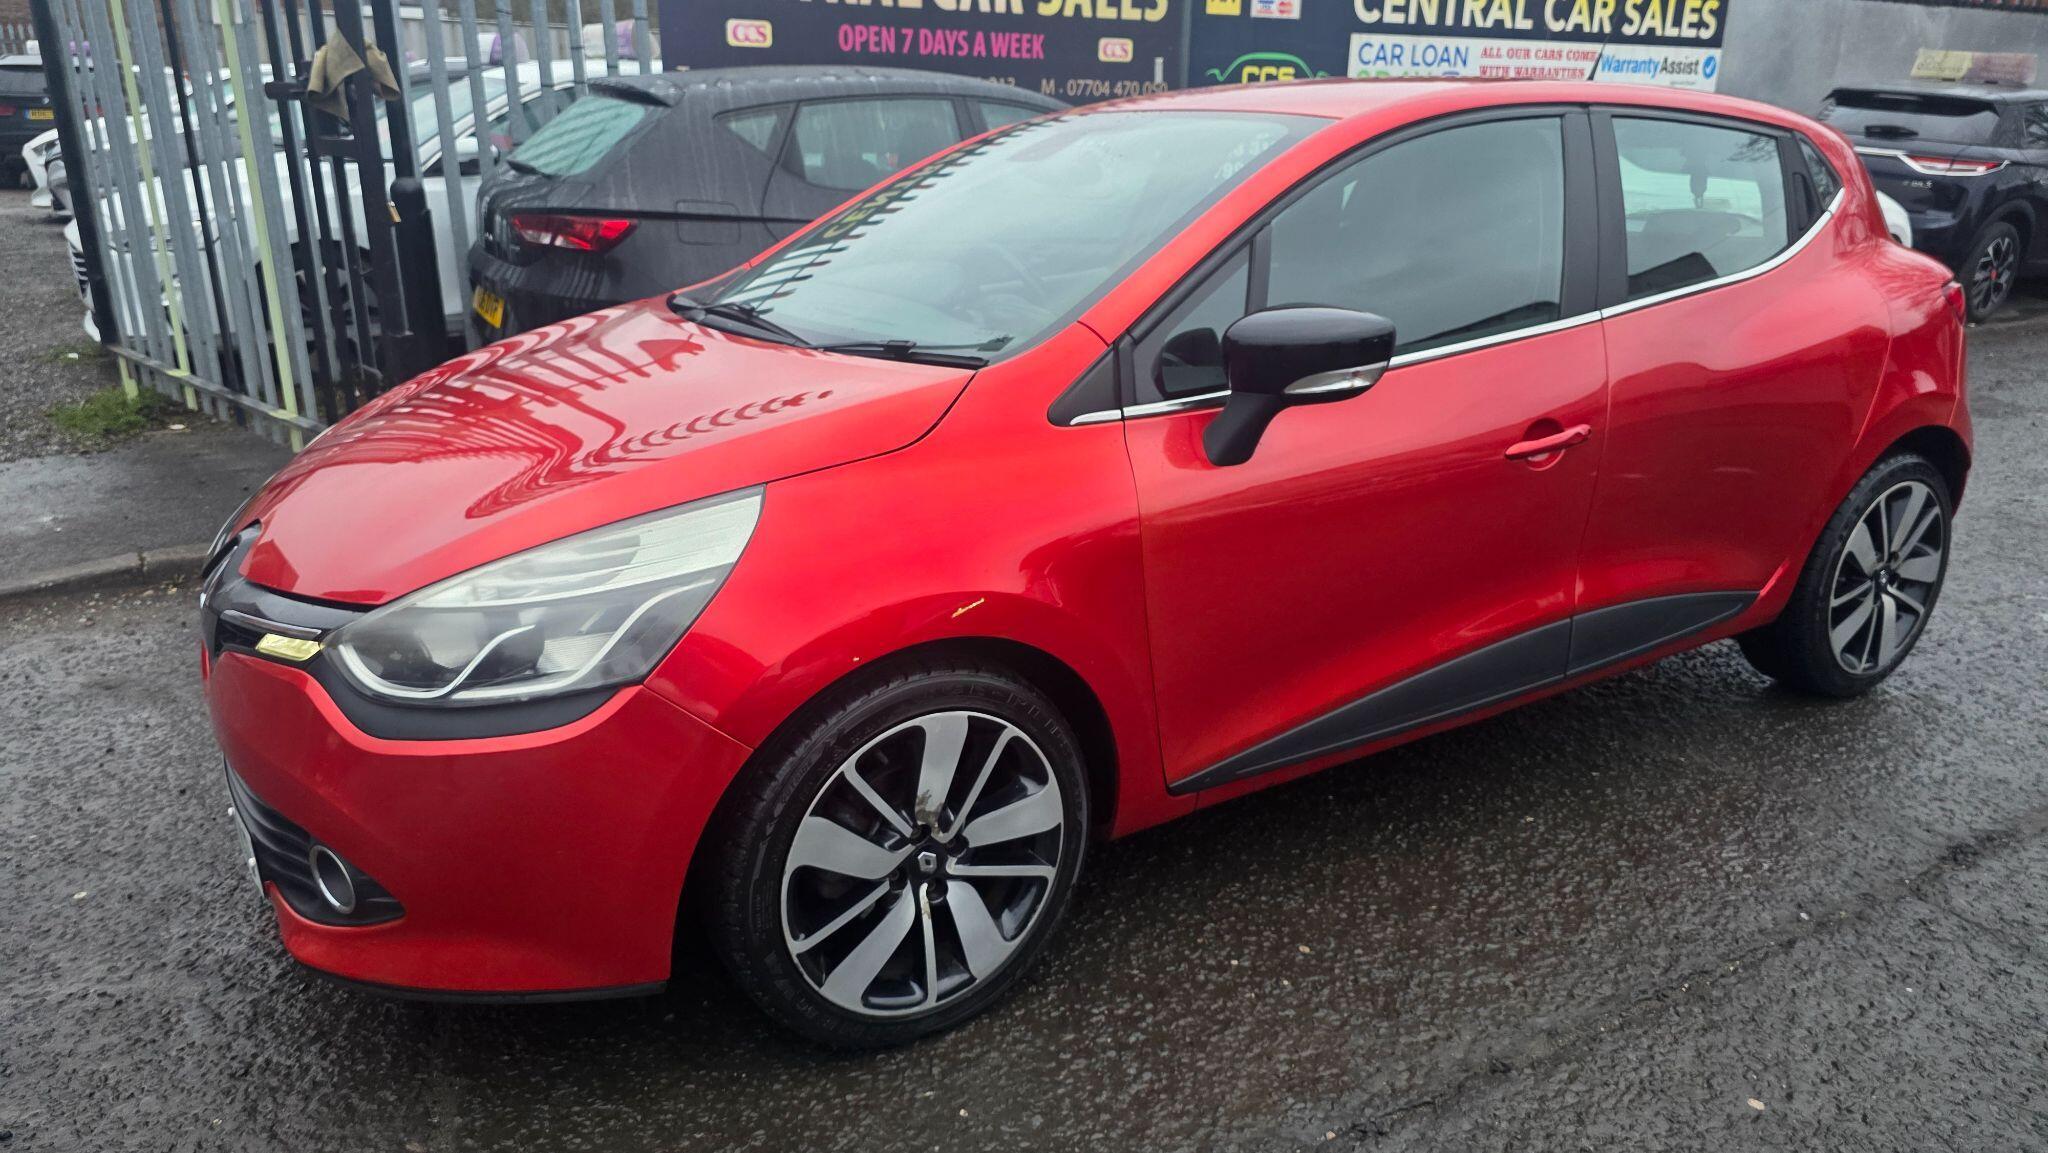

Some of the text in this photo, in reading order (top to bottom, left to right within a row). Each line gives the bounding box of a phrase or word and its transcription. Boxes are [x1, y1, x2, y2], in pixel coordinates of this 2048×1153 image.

[1353, 0, 1720, 39] CENTRAL CAR SALES
[838, 24, 1045, 60] OPEN 7 DAYS A WEEK
[1358, 42, 1470, 67] CAR LOAN
[1480, 47, 1597, 62] ALL OUR CARS COME
[1479, 65, 1585, 79] WITH WARRANTIES
[1066, 79, 1110, 96] 07704
[1113, 80, 1138, 96] 470
